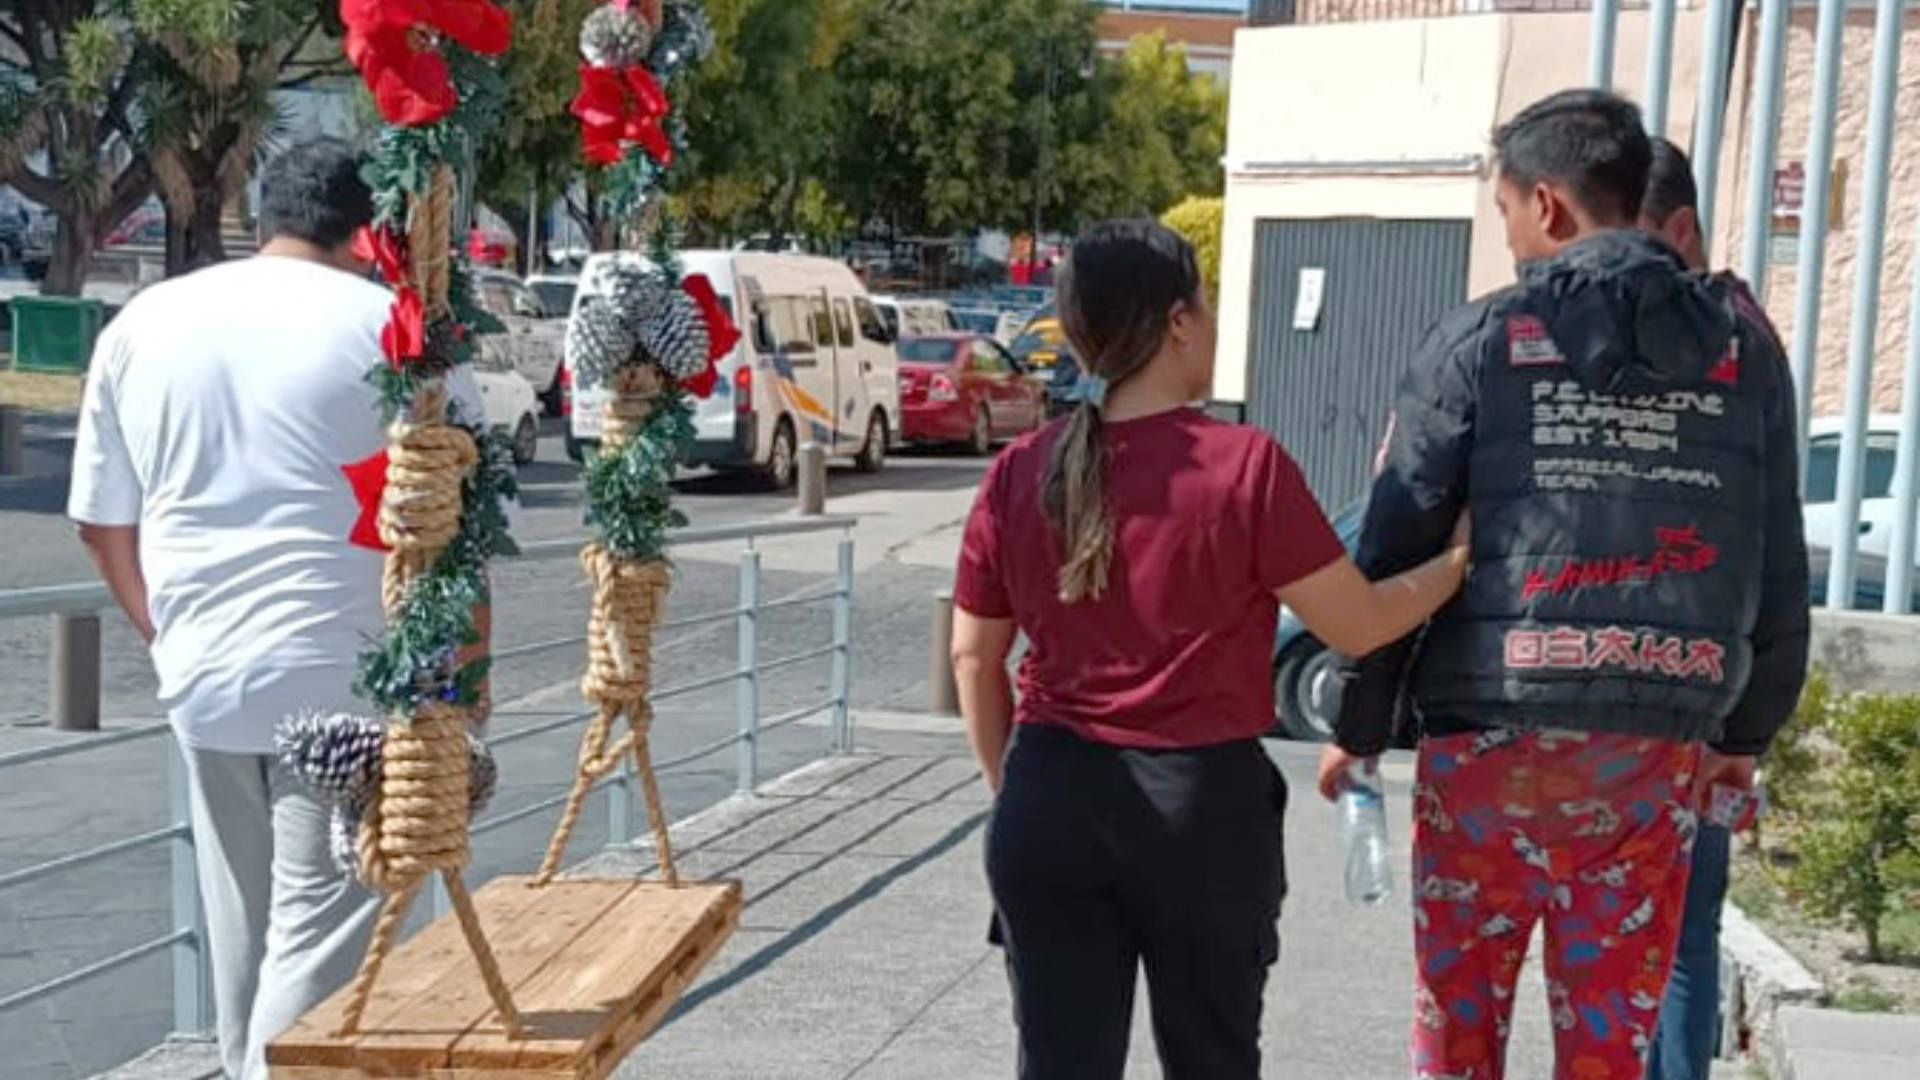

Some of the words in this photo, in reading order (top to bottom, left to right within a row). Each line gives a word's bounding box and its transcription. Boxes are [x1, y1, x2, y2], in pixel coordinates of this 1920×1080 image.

[1533, 403, 1677, 432] SAPPORO
[1533, 426, 1593, 446] EST
[1503, 626, 1725, 683] OSAKA
